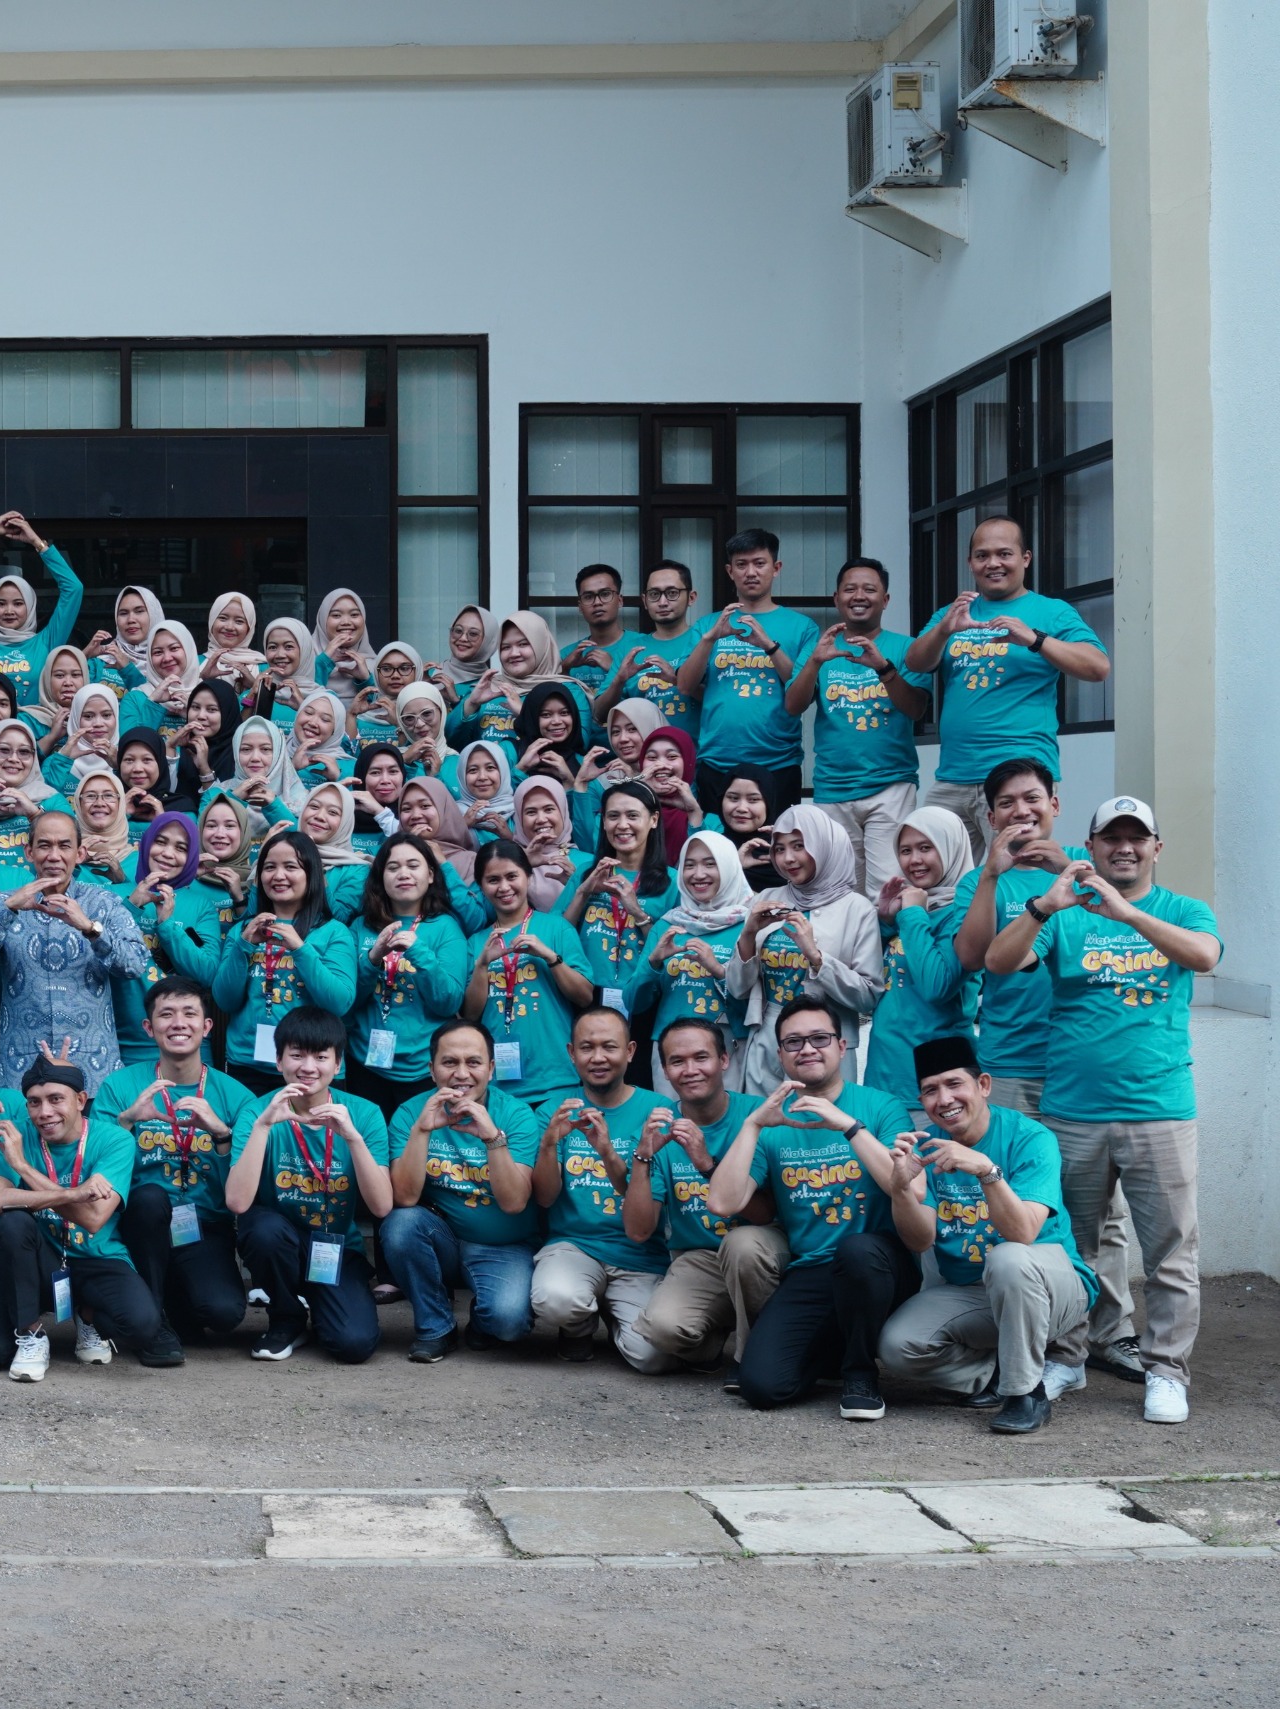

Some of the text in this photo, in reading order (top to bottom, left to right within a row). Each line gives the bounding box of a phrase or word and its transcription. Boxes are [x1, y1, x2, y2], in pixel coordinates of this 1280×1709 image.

[738, 684, 750, 697] 2
[966, 674, 978, 690] 2
[979, 675, 989, 688] 3
[855, 716, 868, 731] 2
[694, 997, 706, 1014] 2
[709, 999, 719, 1012] 3
[1123, 988, 1139, 1007] 2
[1141, 990, 1153, 1005] 3
[603, 1198, 616, 1215] 2
[309, 1214, 322, 1227] 2
[825, 1207, 839, 1225] 2
[842, 1207, 852, 1220] 3
[968, 1244, 983, 1262] 2
